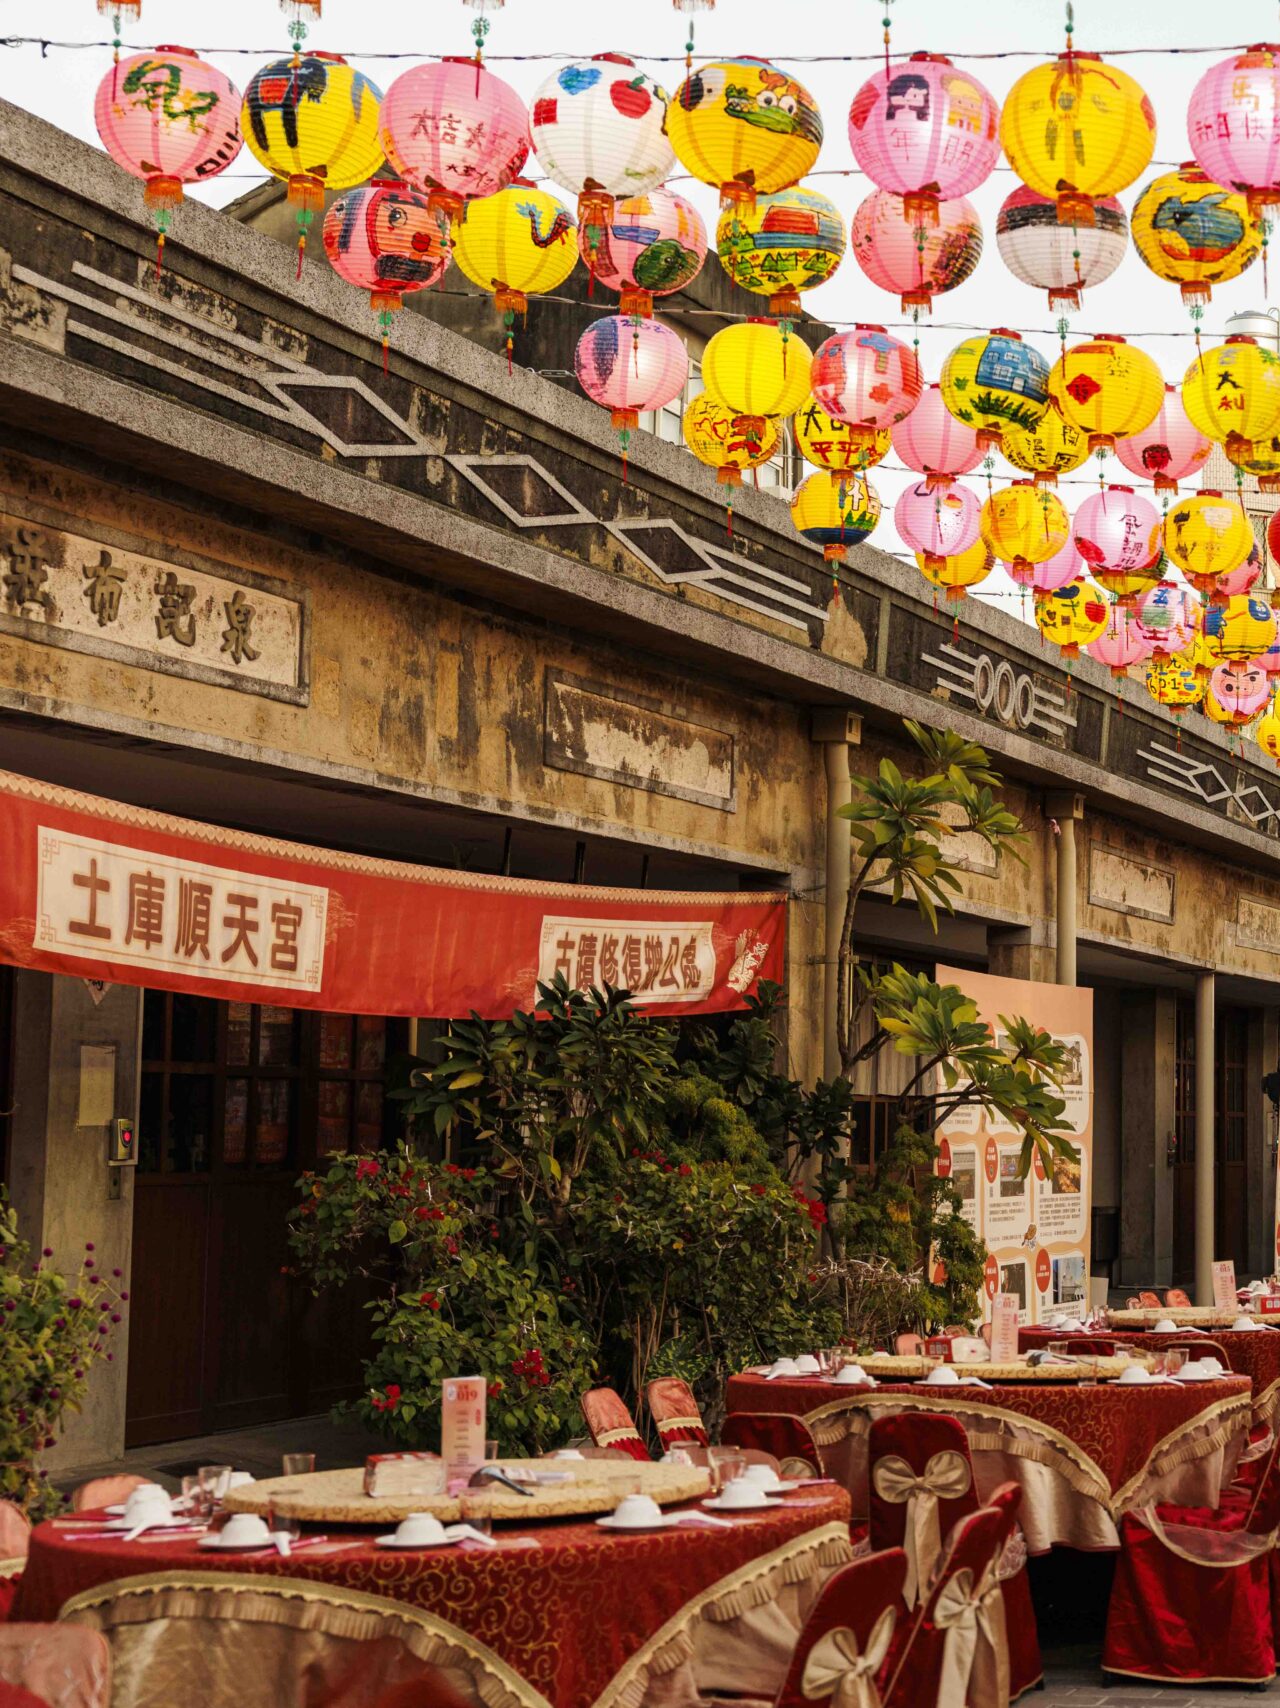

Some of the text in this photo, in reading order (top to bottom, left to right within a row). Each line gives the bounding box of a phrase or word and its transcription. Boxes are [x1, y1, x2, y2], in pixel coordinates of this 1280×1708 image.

[68, 857, 303, 974] 土庫順天宮
[554, 930, 701, 992] 古蹟修復辦公處
[457, 1390, 478, 1401] 019
